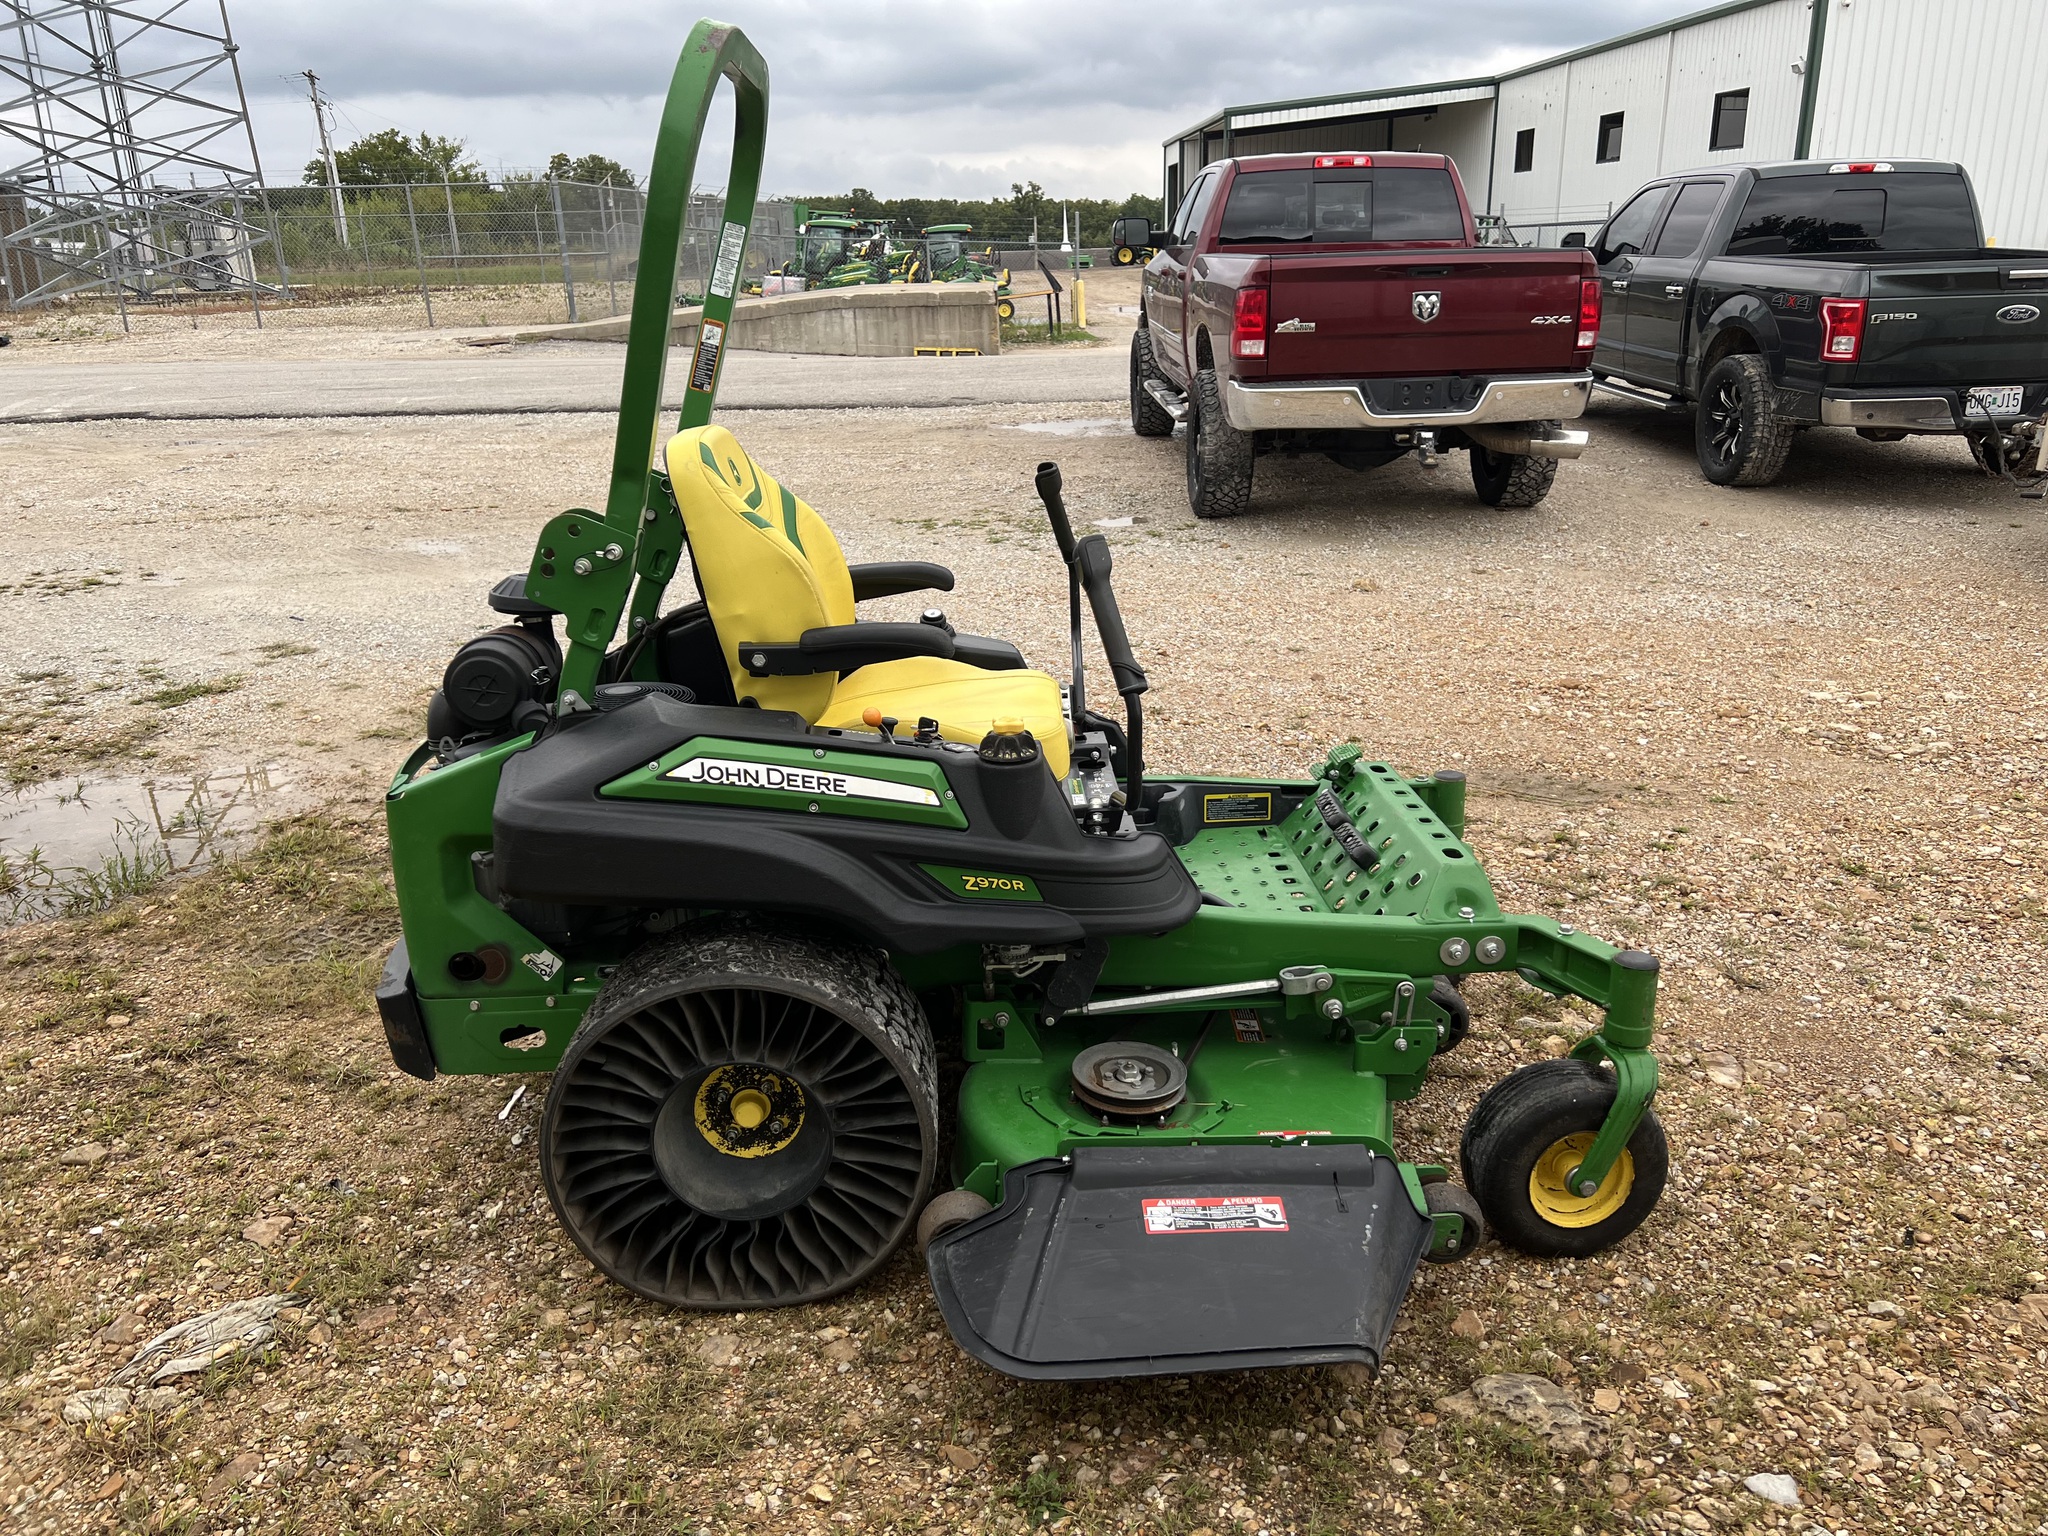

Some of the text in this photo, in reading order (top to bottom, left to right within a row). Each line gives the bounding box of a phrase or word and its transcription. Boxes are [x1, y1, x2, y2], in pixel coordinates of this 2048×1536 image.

[2006, 308, 2031, 320] Ford
[1997, 392, 2021, 408] J15
[692, 761, 847, 794] JOHN DEERE
[1166, 1197, 1264, 1206] DANGER PELIGRO
